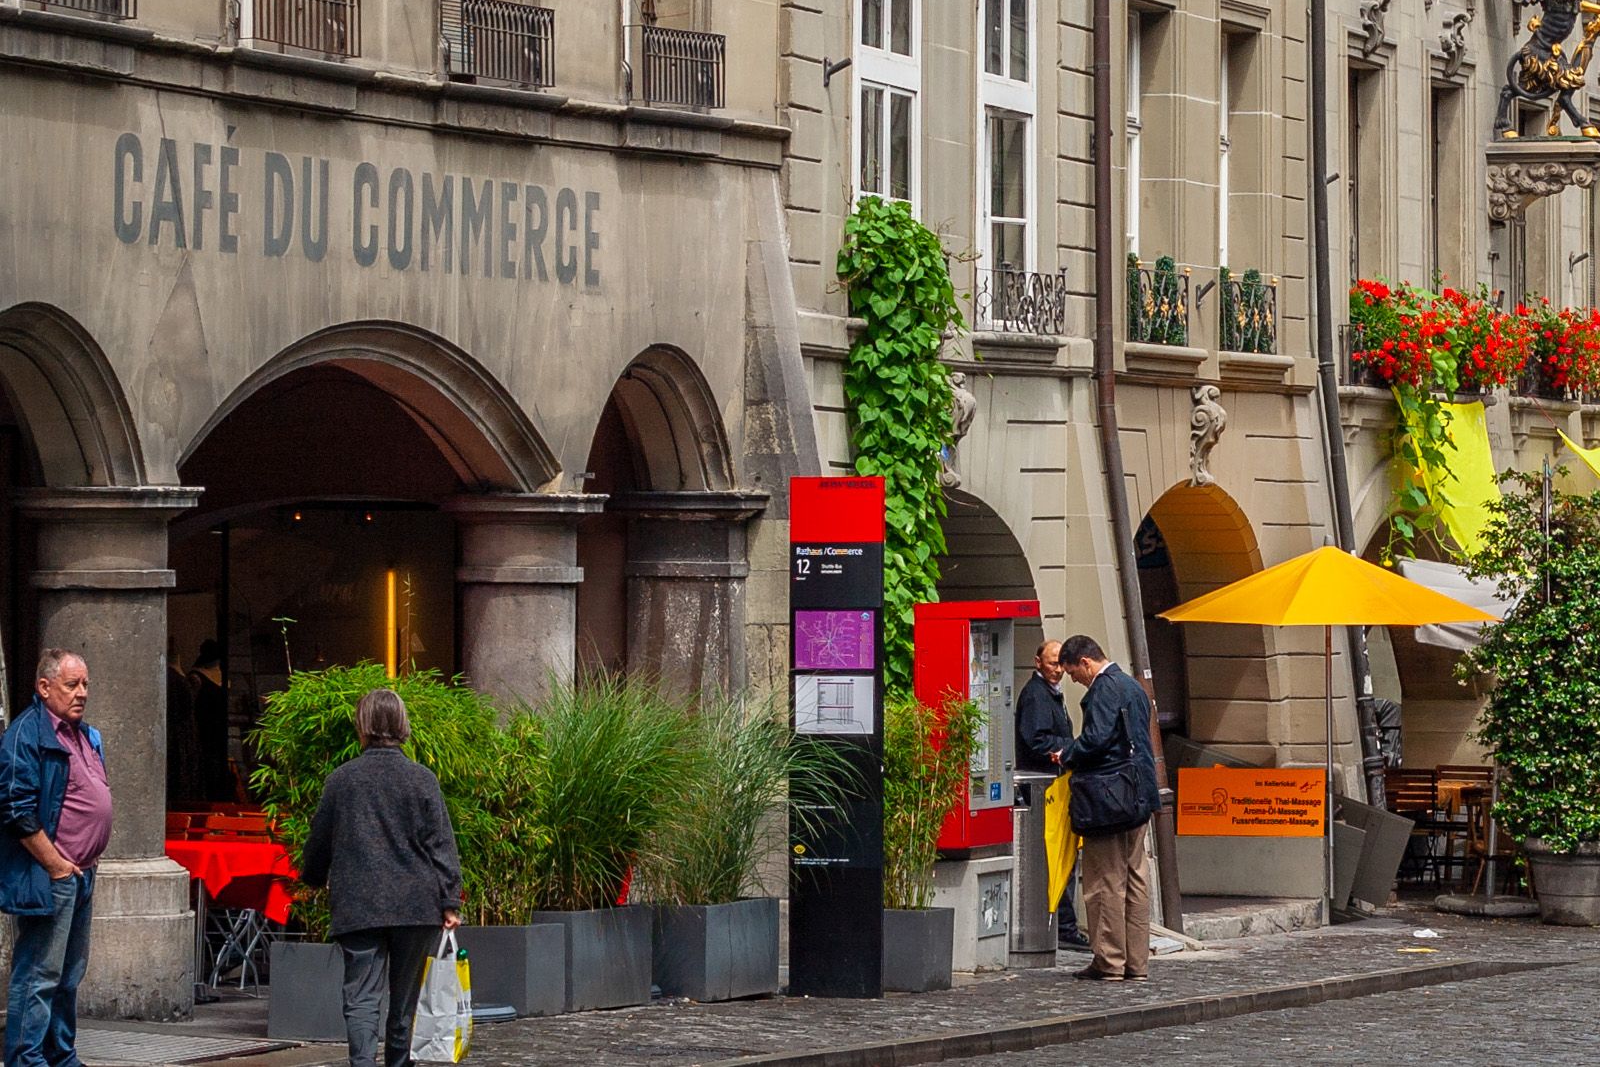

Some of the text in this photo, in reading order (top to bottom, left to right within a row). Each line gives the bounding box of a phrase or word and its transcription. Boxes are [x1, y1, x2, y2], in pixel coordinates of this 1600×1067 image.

[113, 126, 602, 287] CAFÉ DU COMMERCE
[796, 558, 810, 574] 12
